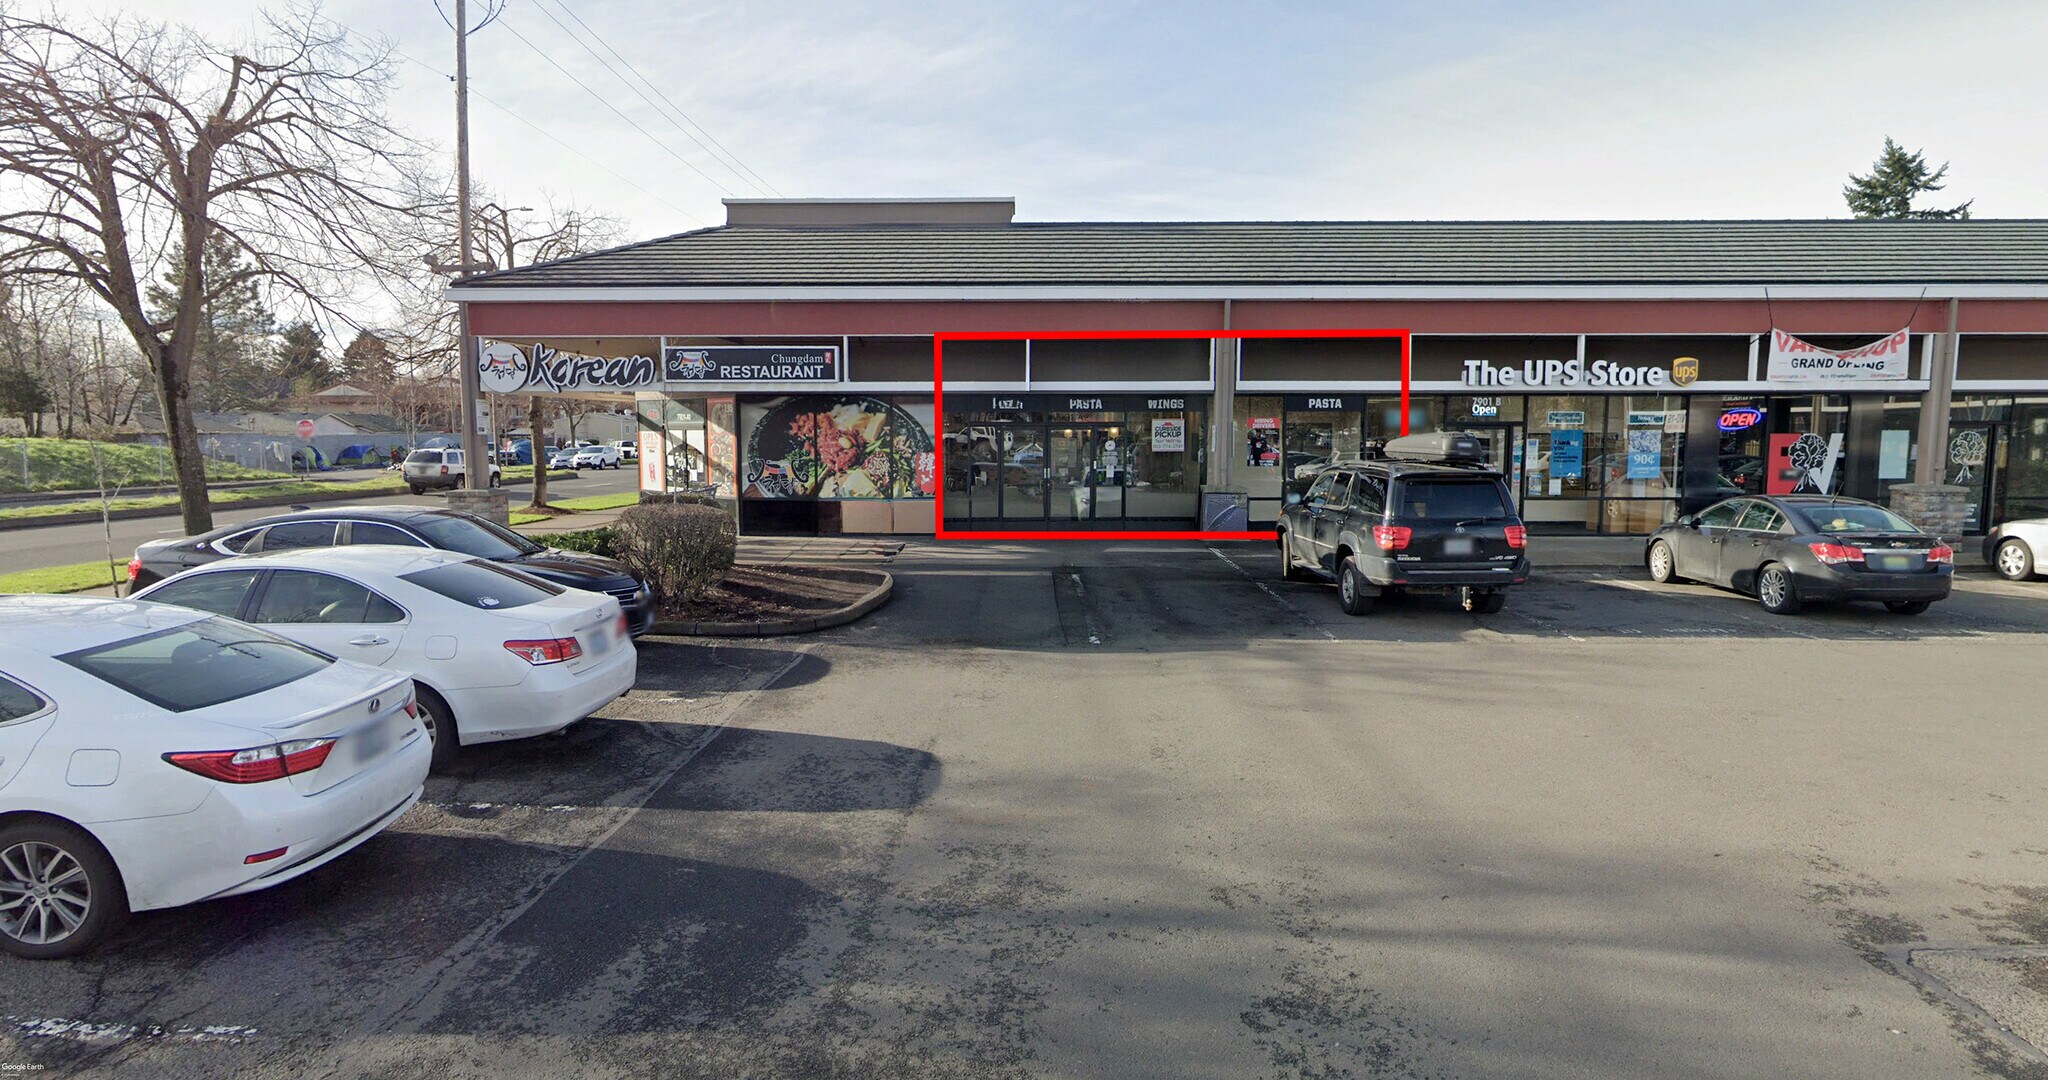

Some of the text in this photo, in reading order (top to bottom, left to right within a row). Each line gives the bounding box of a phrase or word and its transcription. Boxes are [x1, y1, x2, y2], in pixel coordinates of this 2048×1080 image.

[771, 354, 823, 365] Chungdam
[1791, 358, 1833, 369] GRAND
[530, 343, 655, 392] Korean
[720, 365, 824, 379] RESTAURANT
[1464, 360, 1663, 386] The UPS Store
[1069, 398, 1103, 410] PASTA
[1147, 399, 1184, 409] WINGS
[1308, 398, 1342, 409] PASTA
[1472, 397, 1502, 406] 7901 B
[1472, 405, 1497, 416] Open
[1720, 413, 1757, 427] OPEN
[1633, 454, 1655, 465] 90¢
